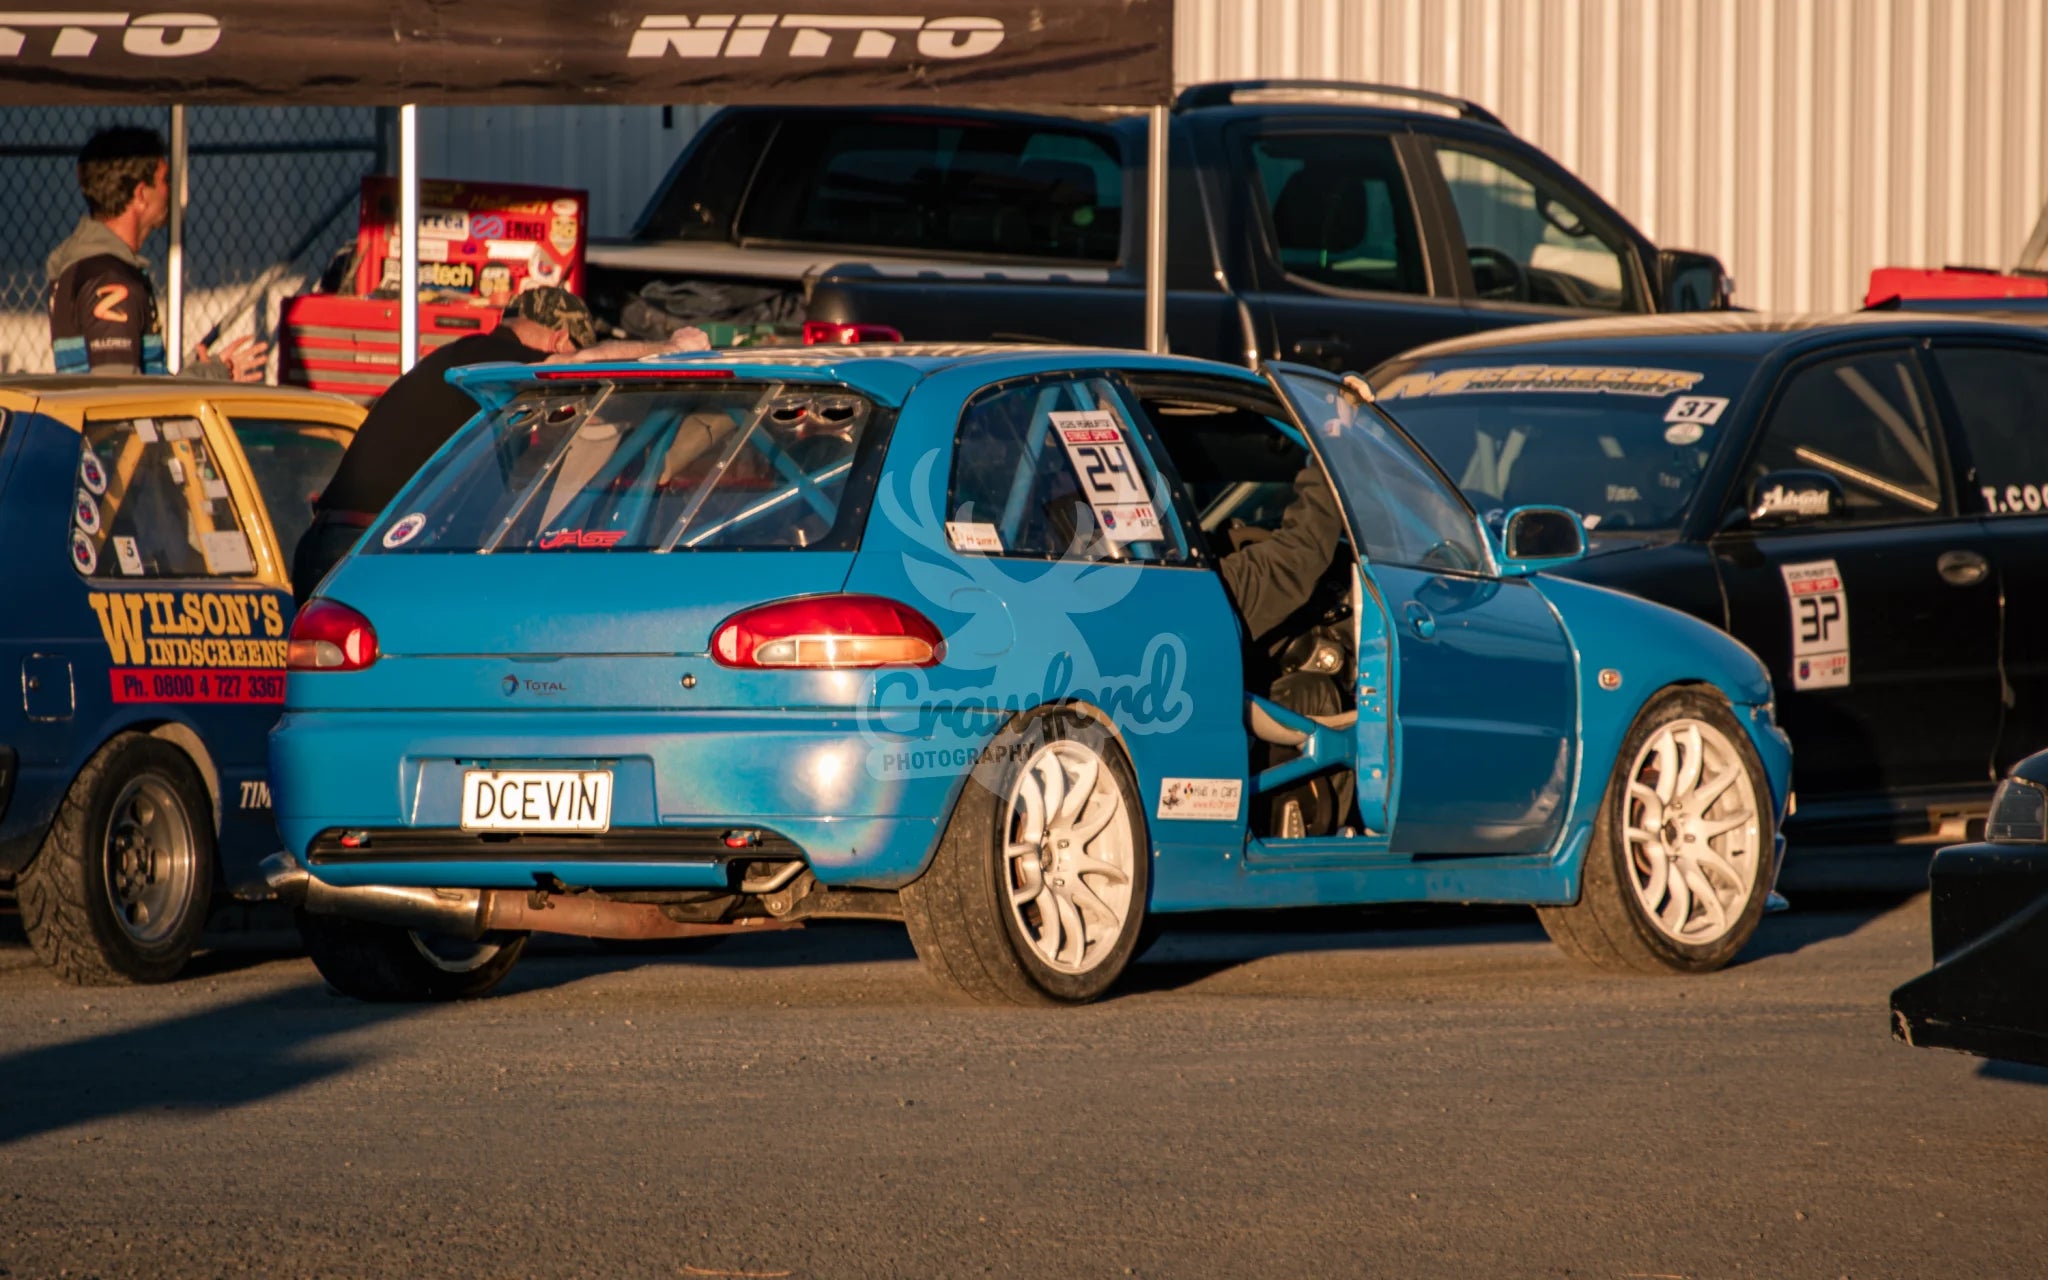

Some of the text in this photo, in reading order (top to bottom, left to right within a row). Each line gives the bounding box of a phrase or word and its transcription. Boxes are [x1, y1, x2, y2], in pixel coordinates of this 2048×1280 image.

[627, 14, 1004, 58] NITTO
[1677, 400, 1718, 418] 37
[1077, 446, 1138, 492] 24
[88, 592, 284, 665] WILSON'S
[124, 674, 285, 698] Ph. 0800 4 727 3367
[475, 780, 599, 821] DCEVIN
